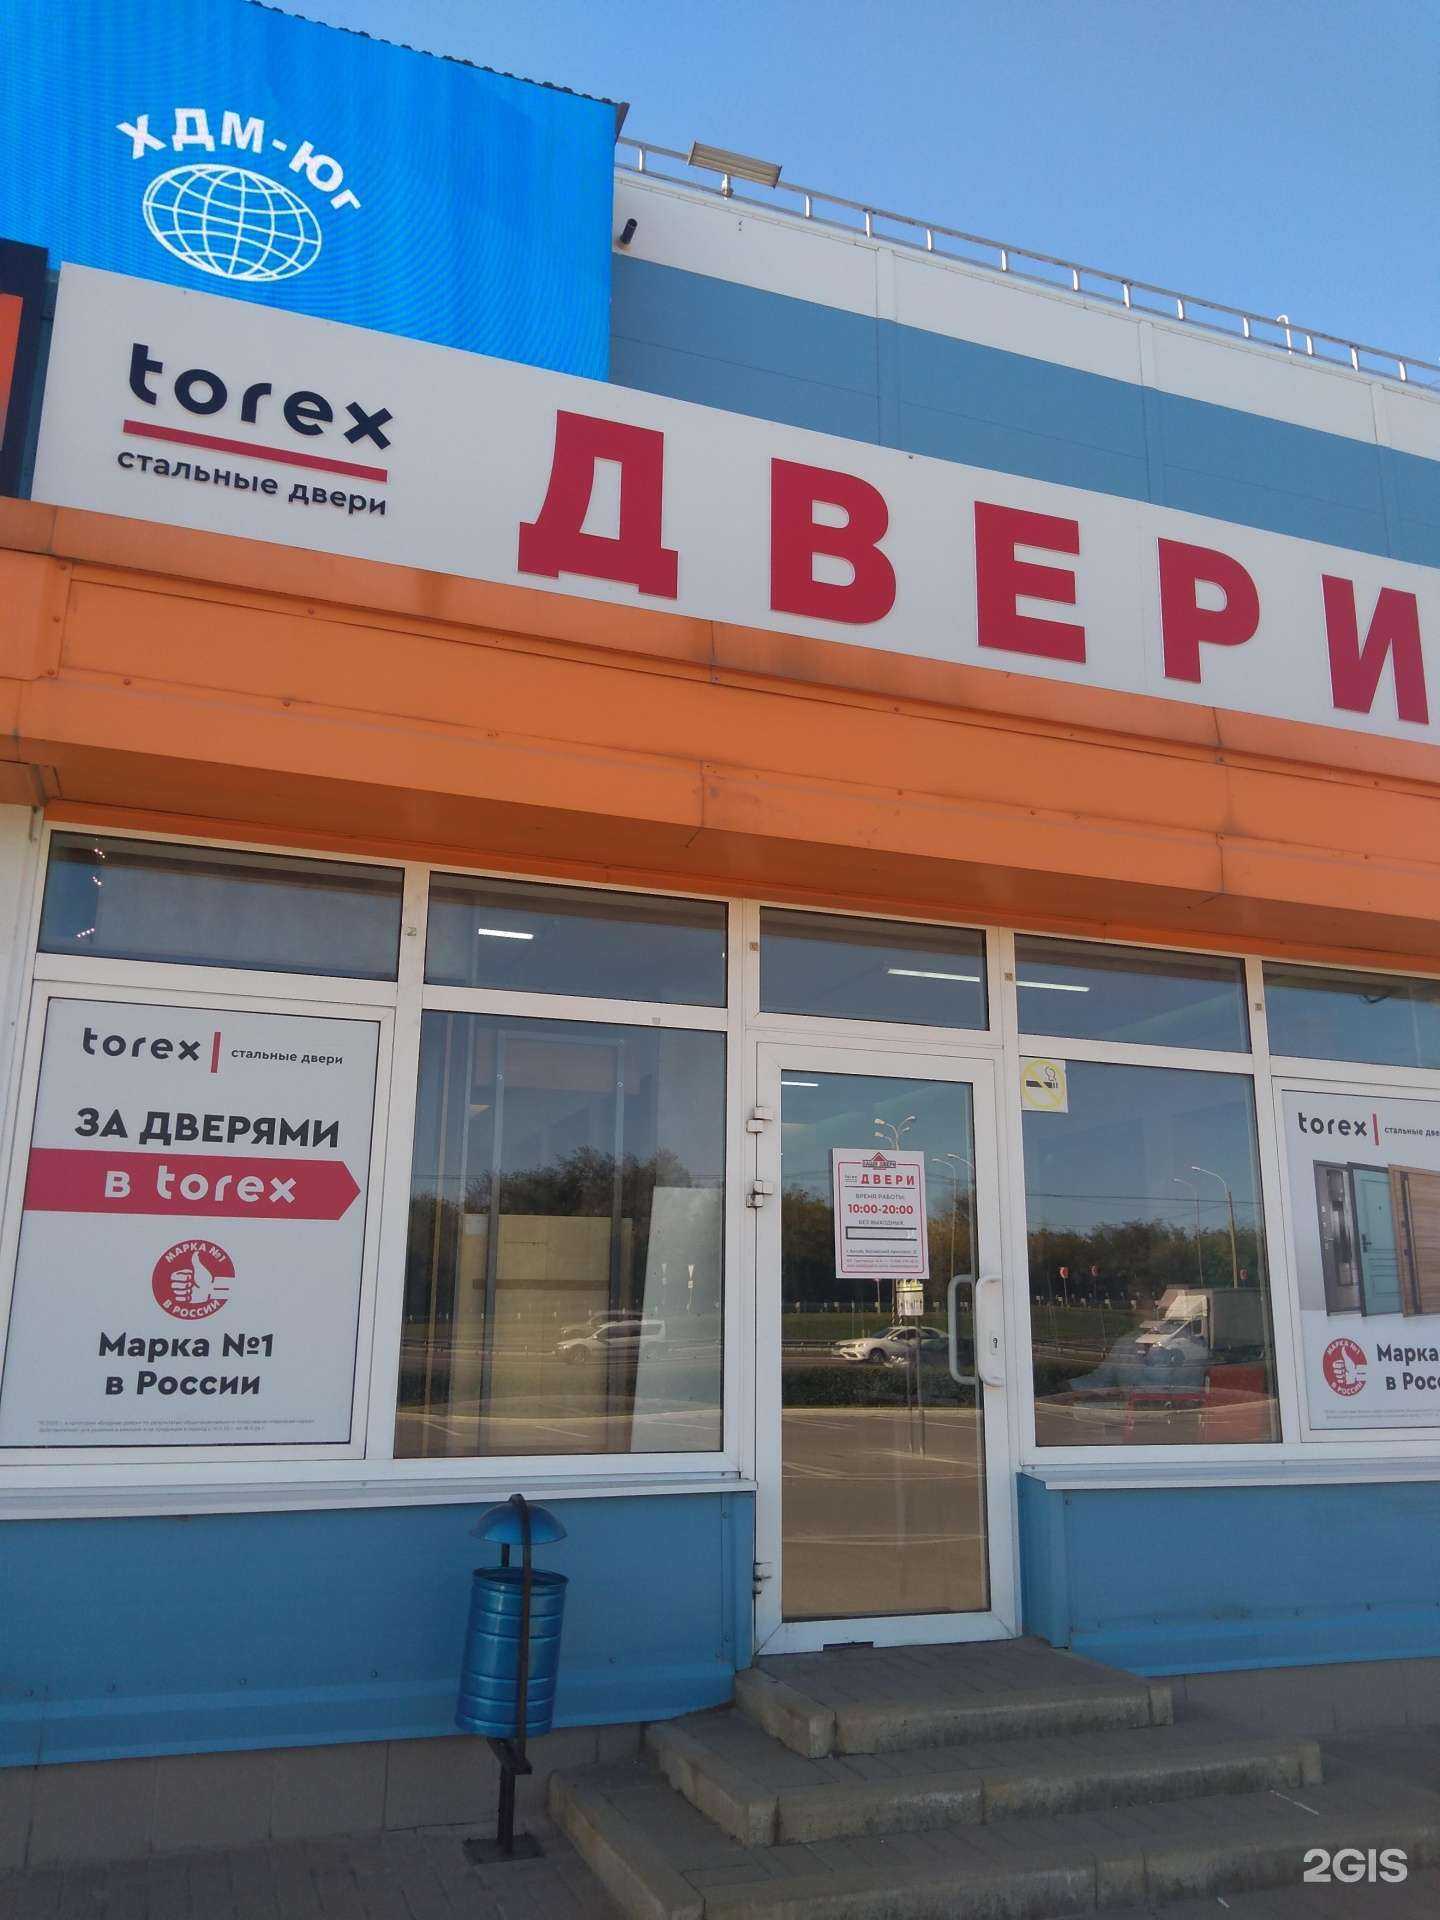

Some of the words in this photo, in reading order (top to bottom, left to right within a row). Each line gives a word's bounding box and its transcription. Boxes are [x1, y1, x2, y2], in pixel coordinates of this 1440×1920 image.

[129, 343, 393, 450] torex
[117, 448, 278, 495] стальные
[288, 482, 387, 516] двери
[517, 409, 1430, 725] ДВЕРИ
[82, 1027, 201, 1061] torex
[231, 1047, 297, 1063] стальные
[300, 1054, 343, 1066] двери
[75, 1107, 128, 1138] ЗА
[138, 1110, 339, 1148] ДВЕРЯМИ
[1297, 1112, 1368, 1137] torex
[1384, 1127, 1423, 1136] стальные
[156, 1165, 297, 1204] torex
[861, 1174, 915, 1186] ДВЕРИ
[848, 1204, 914, 1214] 10:00-20:00
[165, 1242, 207, 1263] МАРКА
[163, 1299, 172, 1309] В
[172, 1299, 221, 1317] РОССИИ
[98, 1331, 210, 1363] Марка
[221, 1332, 274, 1357] №1
[1376, 1343, 1439, 1366] Марка
[105, 1376, 124, 1395] в
[136, 1371, 261, 1395] России
[1386, 1376, 1396, 1391] в
